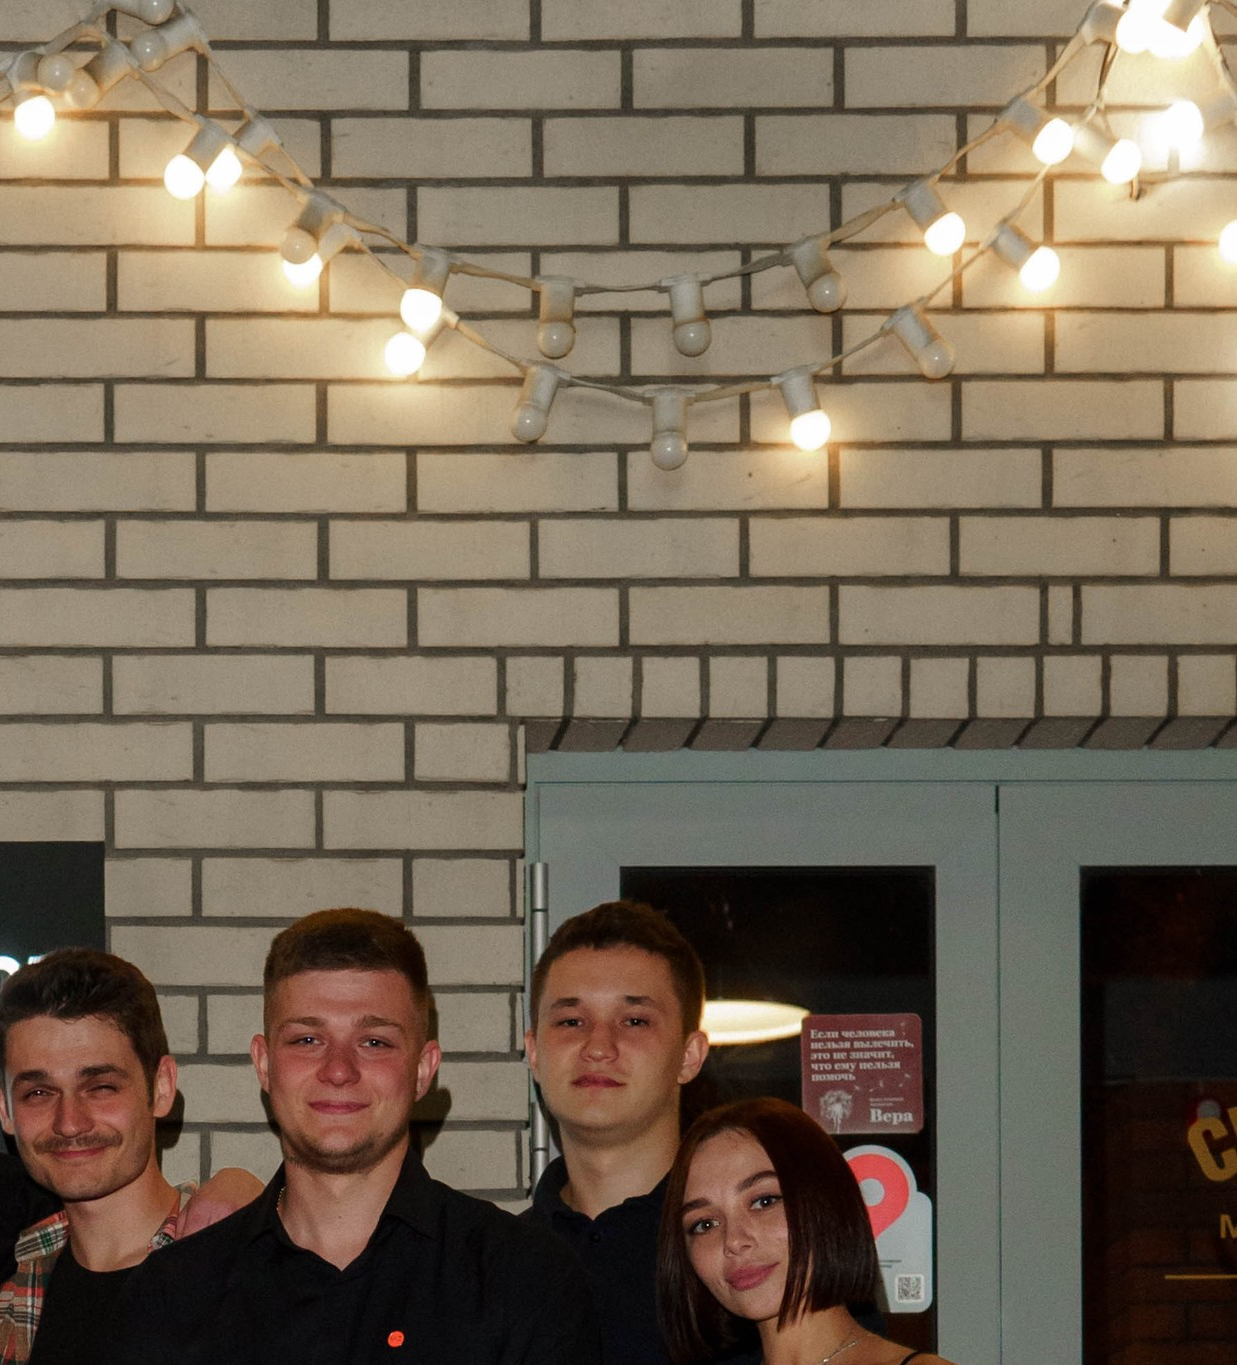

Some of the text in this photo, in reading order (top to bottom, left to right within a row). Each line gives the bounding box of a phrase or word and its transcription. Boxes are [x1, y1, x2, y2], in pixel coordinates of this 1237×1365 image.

[810, 1029, 895, 1039] Если человека
[810, 1040, 914, 1049] нельзя вылечить,
[810, 1052, 830, 1060] это
[833, 1051, 848, 1060] не
[811, 1061, 901, 1072] что ему нельзя
[811, 1073, 856, 1081] помочь
[869, 1108, 913, 1125] Вера
